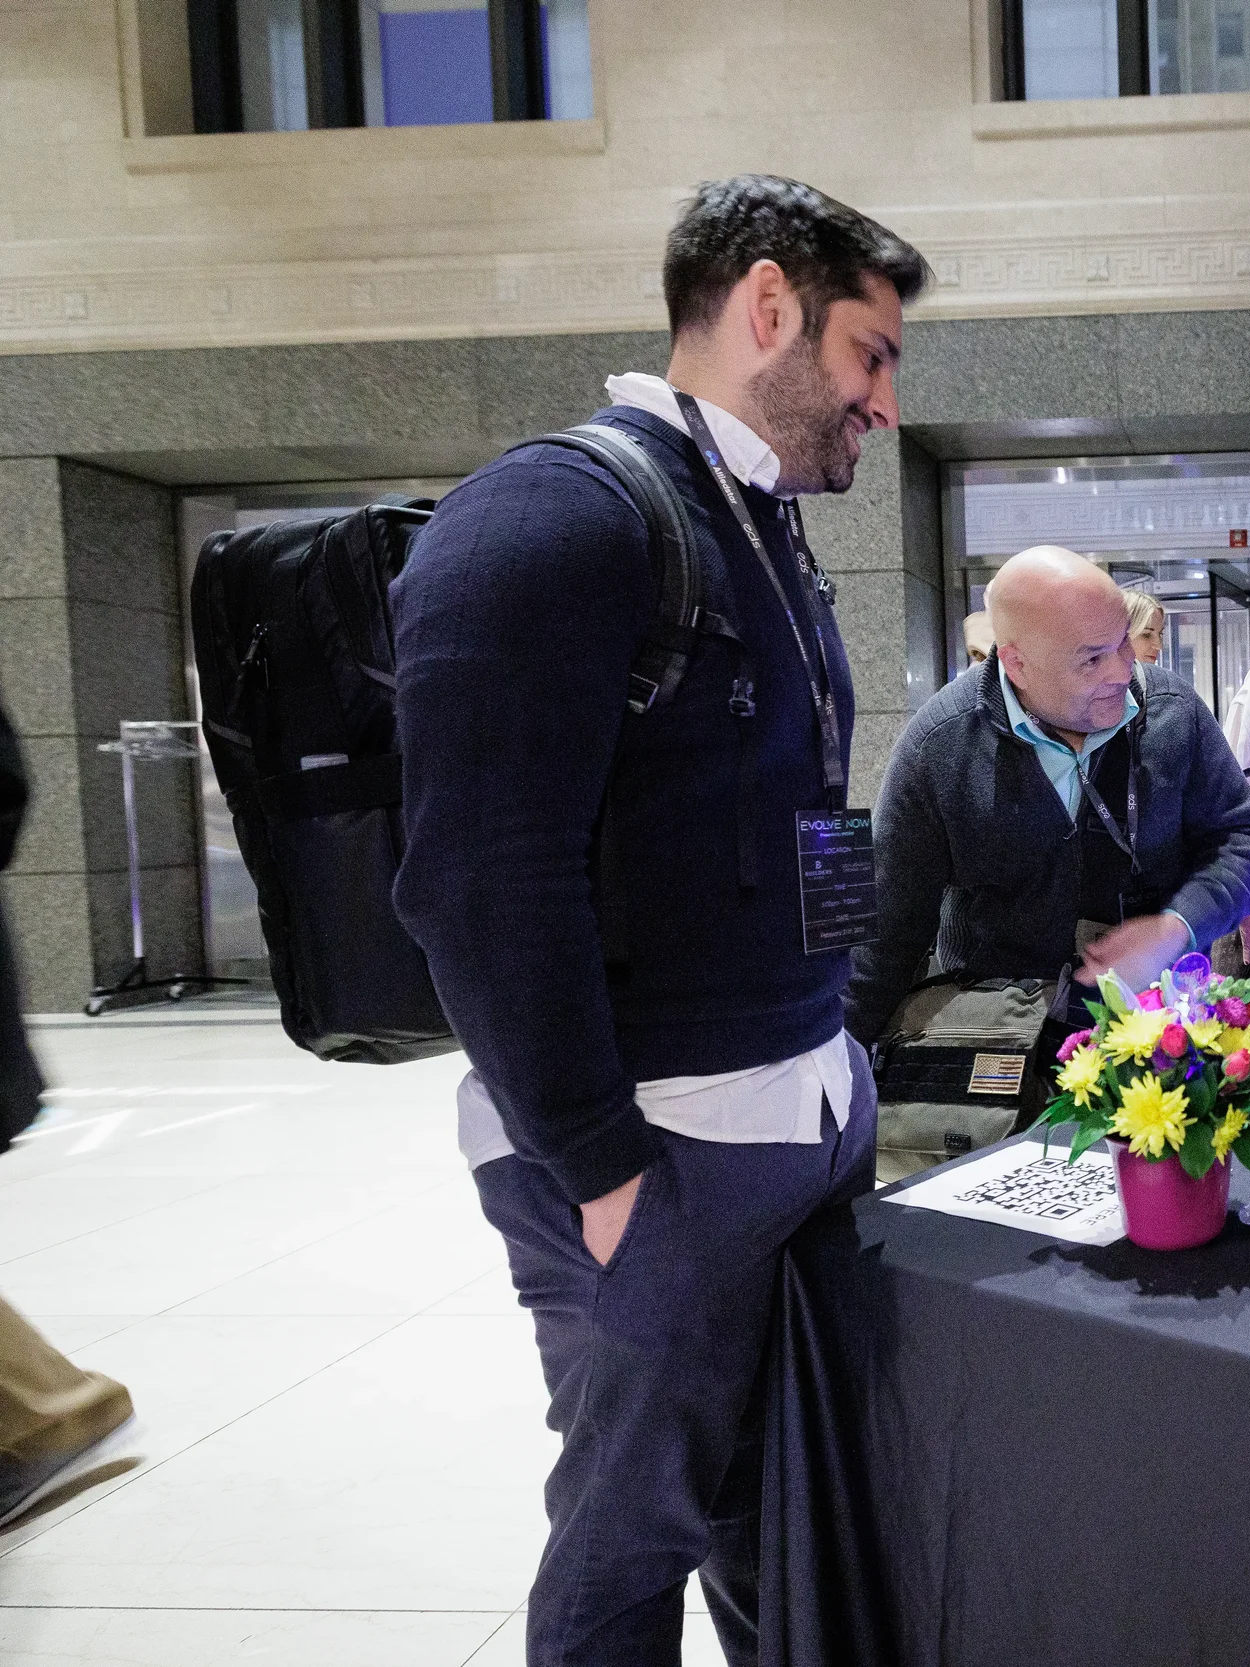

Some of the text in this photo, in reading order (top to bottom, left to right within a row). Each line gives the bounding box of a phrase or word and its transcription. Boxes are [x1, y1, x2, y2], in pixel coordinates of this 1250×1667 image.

[713, 466, 737, 505] Alliedstar
[788, 505, 799, 537] Alliedstar
[743, 523, 761, 549] eds
[797, 551, 810, 574] eds
[1128, 793, 1137, 811] eds
[800, 818, 870, 831] EVOLVE NOW
